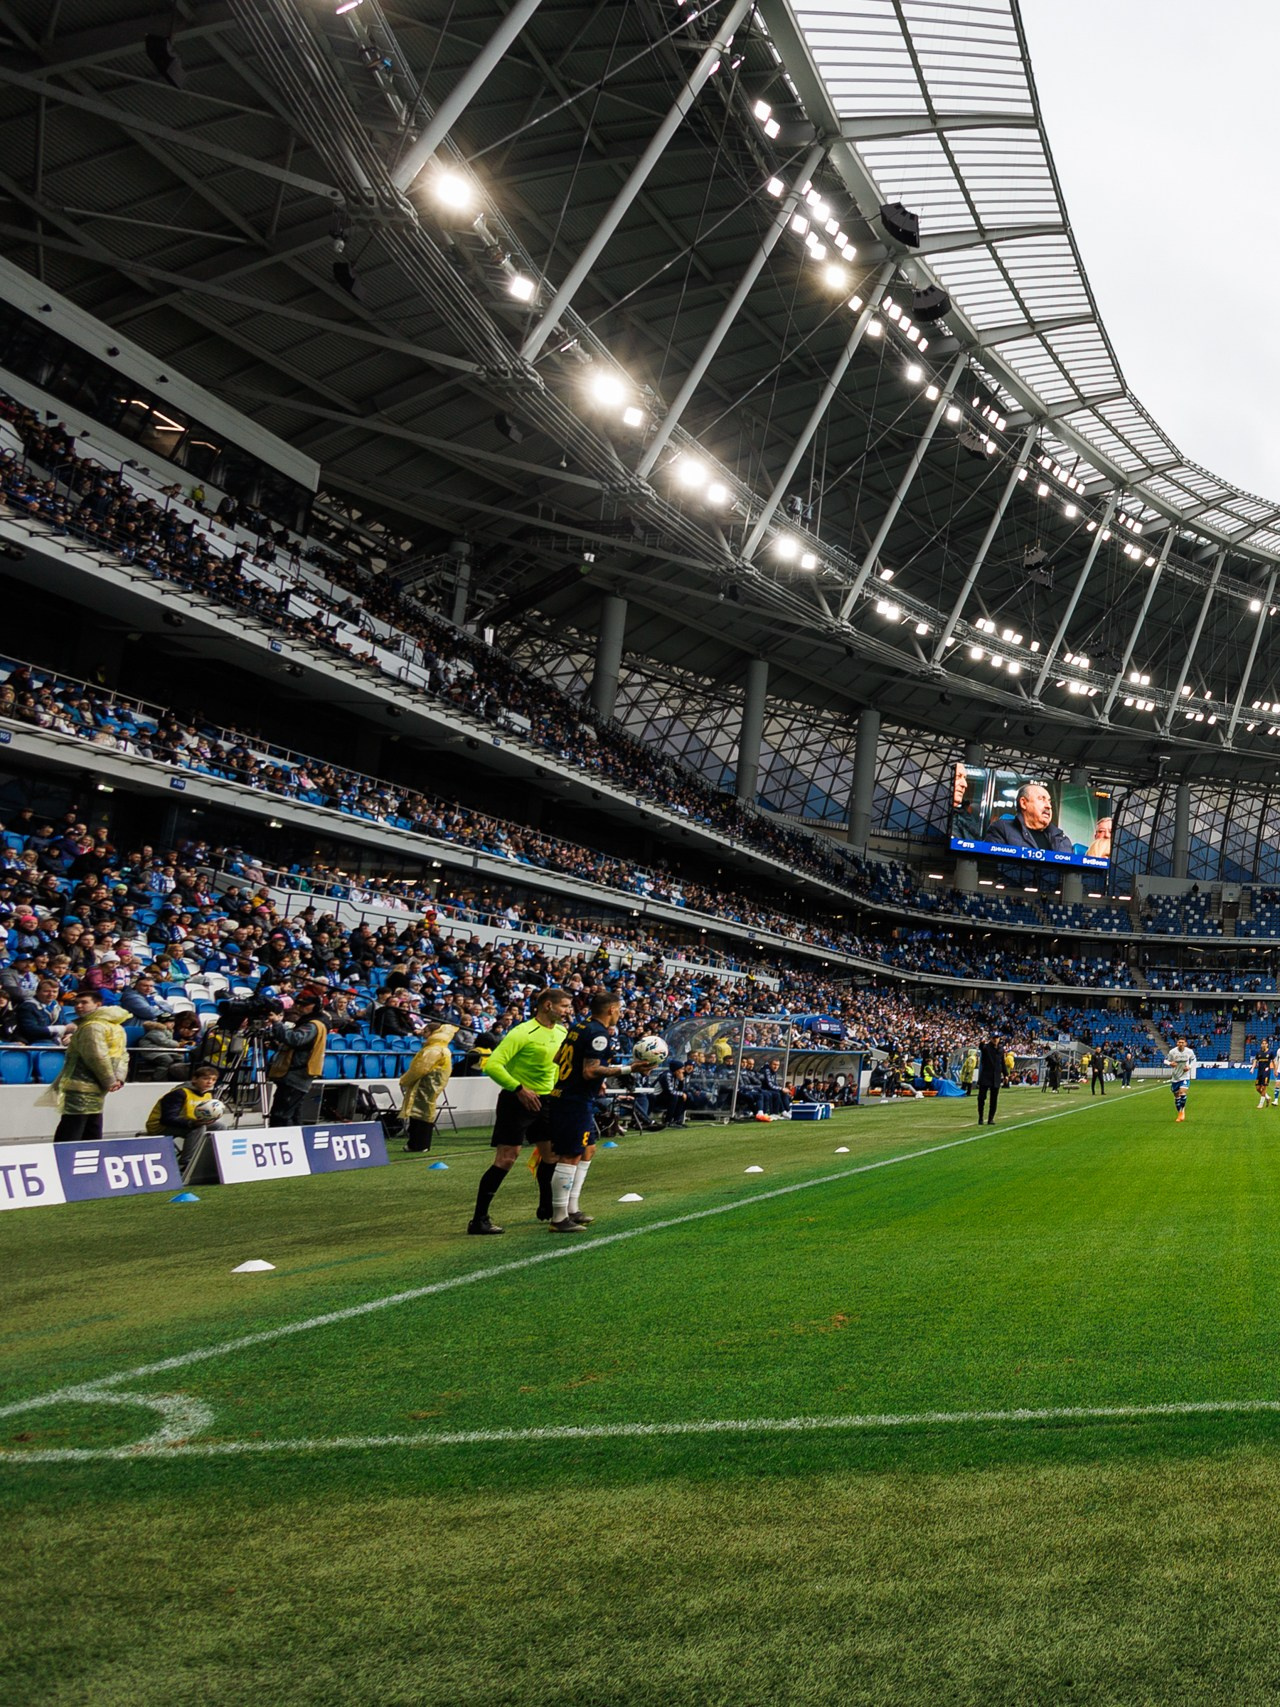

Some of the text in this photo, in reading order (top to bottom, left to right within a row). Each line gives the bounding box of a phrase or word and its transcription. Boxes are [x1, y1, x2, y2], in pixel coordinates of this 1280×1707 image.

[990, 845, 1017, 854] ДИНАМО
[1027, 850, 1042, 859] 1:0
[1082, 857, 1108, 867] BetBoom
[252, 1141, 294, 1167] ВТБ
[331, 1134, 371, 1161] ВТБ
[0, 1163, 45, 1199] ТБ
[104, 1153, 168, 1190] ВТБ
